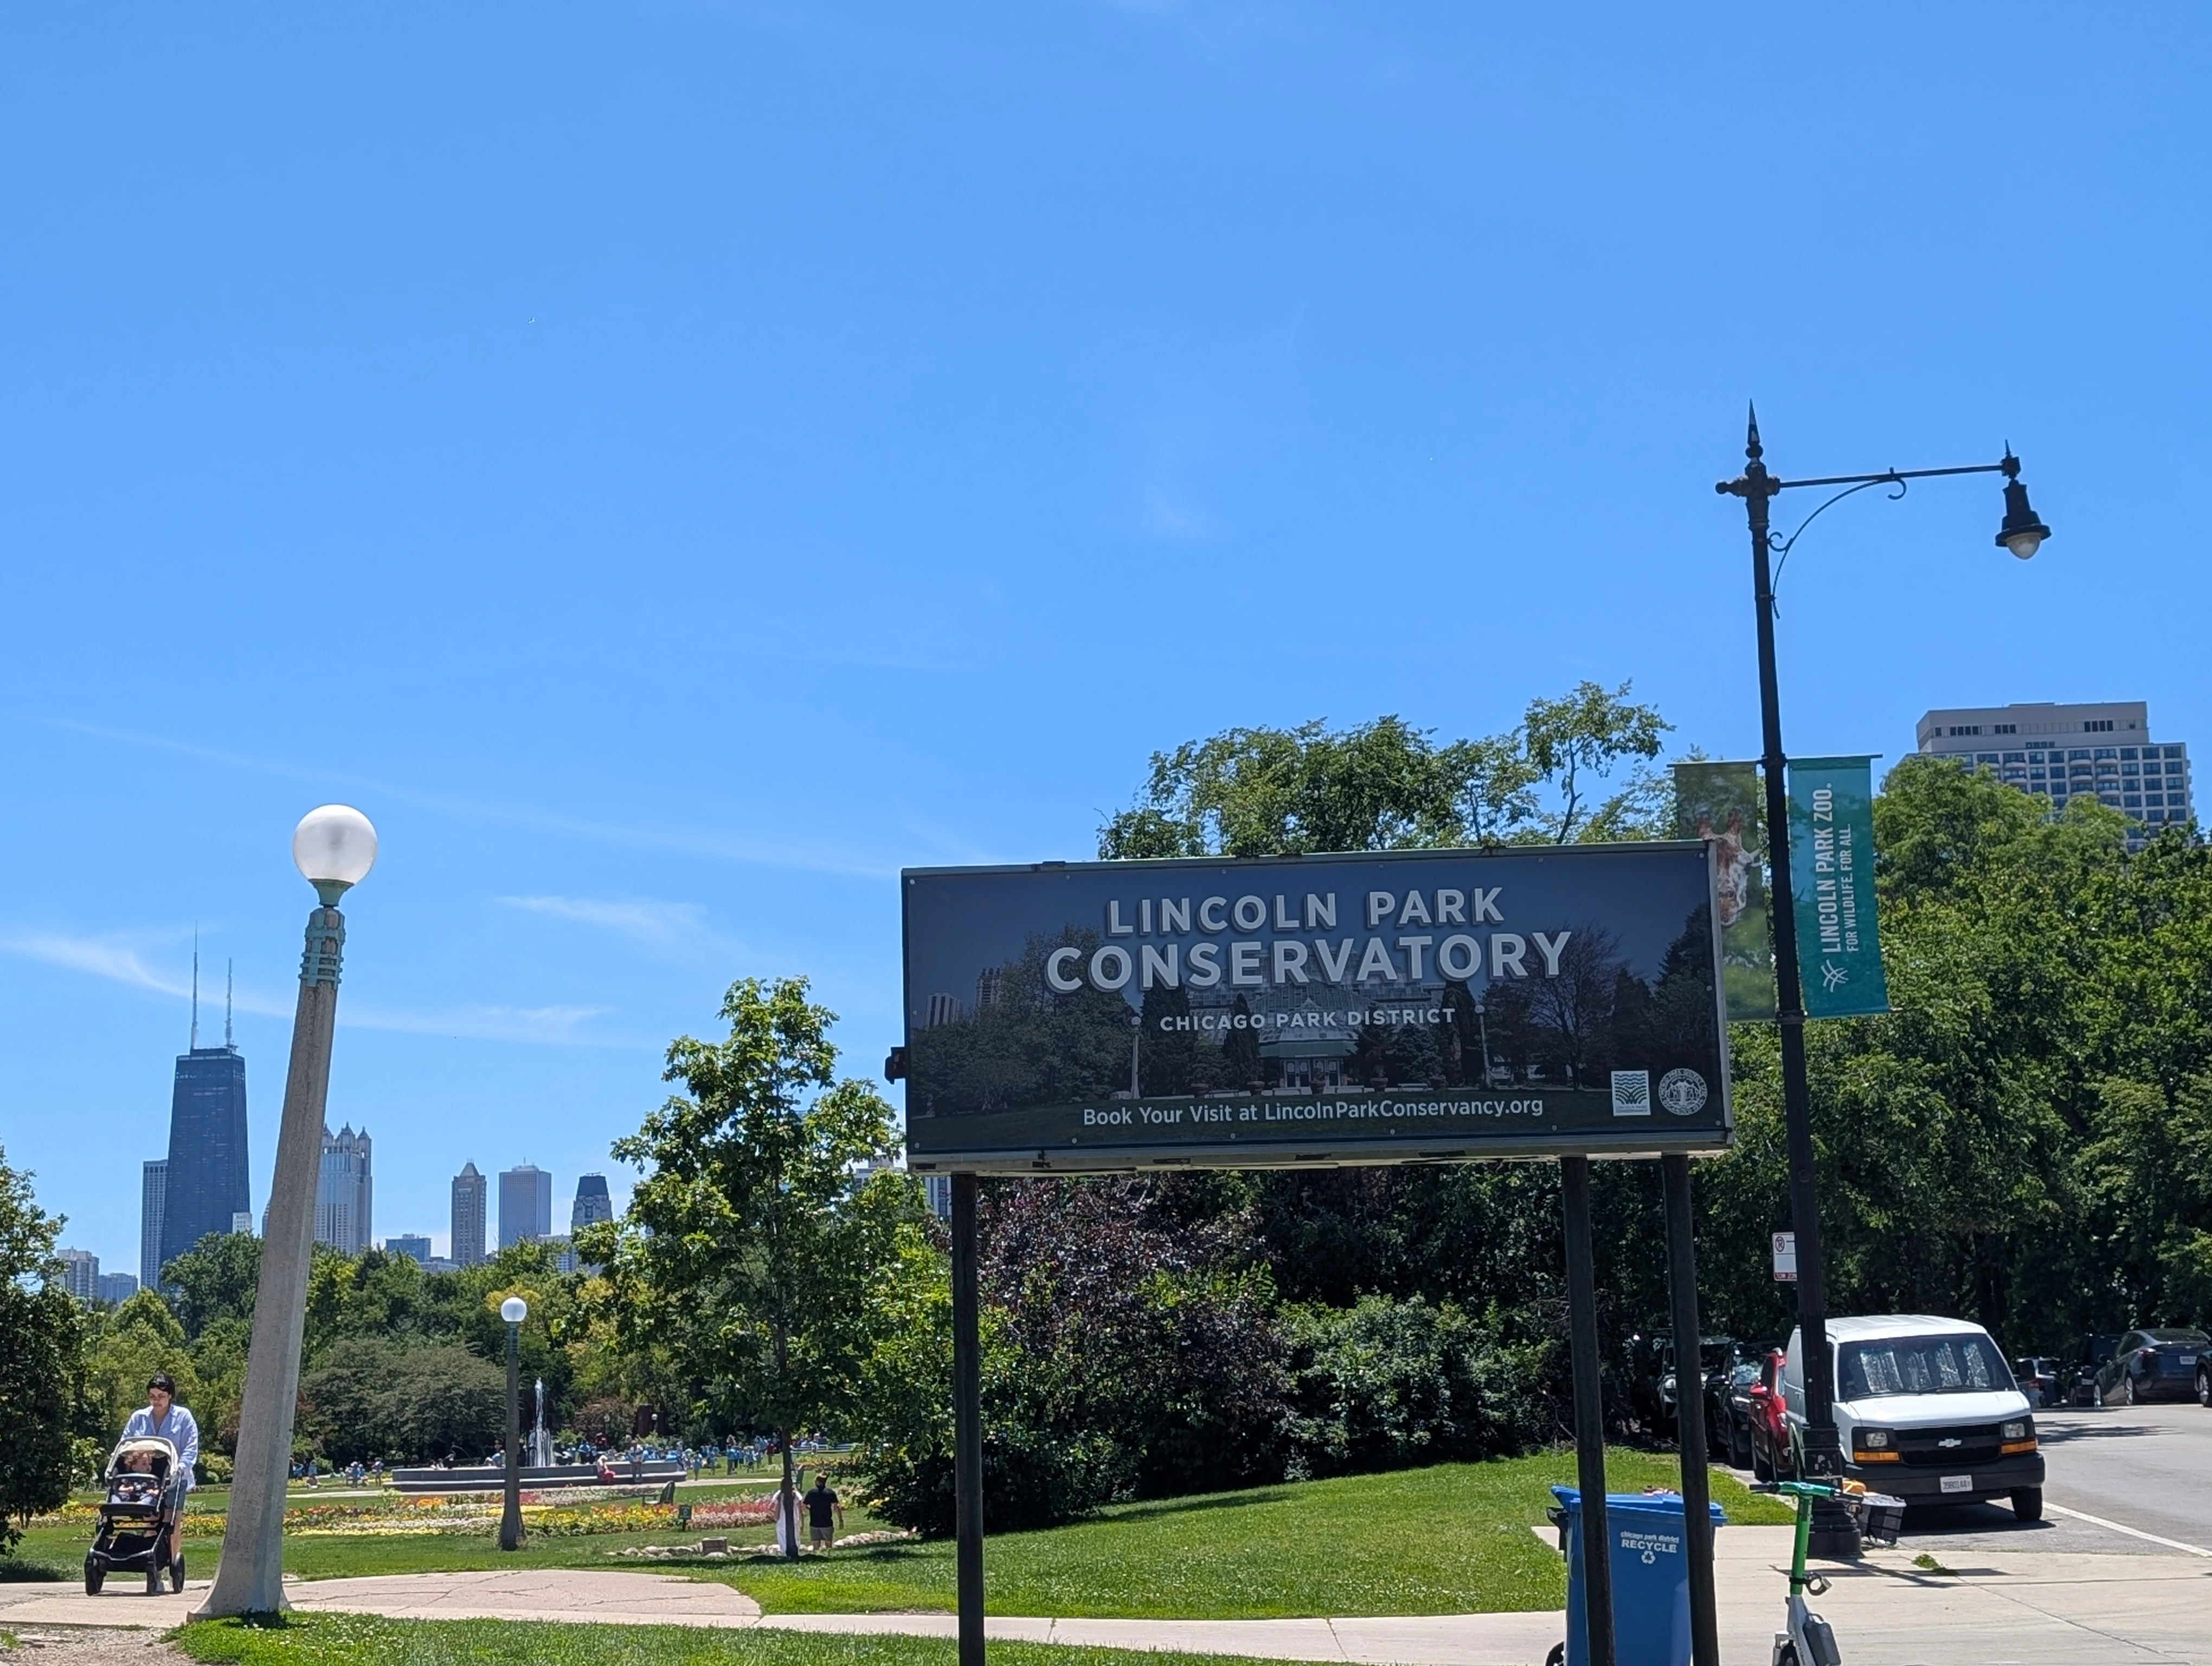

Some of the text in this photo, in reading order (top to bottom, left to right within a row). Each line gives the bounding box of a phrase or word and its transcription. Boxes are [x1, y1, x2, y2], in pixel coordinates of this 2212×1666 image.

[1812, 783, 1842, 953] LINCOLN PARK ZOO.
[1840, 849, 1853, 871] FOR
[1108, 887, 1504, 936] LINCOLN PARK
[1846, 931, 1859, 952] FOR
[1045, 931, 1572, 994] CONSERVATORY
[1160, 1008, 1456, 1031] CHICAGO PARK DISTRICT
[1084, 1099, 1543, 1125] Book Your Visit at LincolnParkConservancy.org
[1621, 1539, 1677, 1553] RECYCLE
